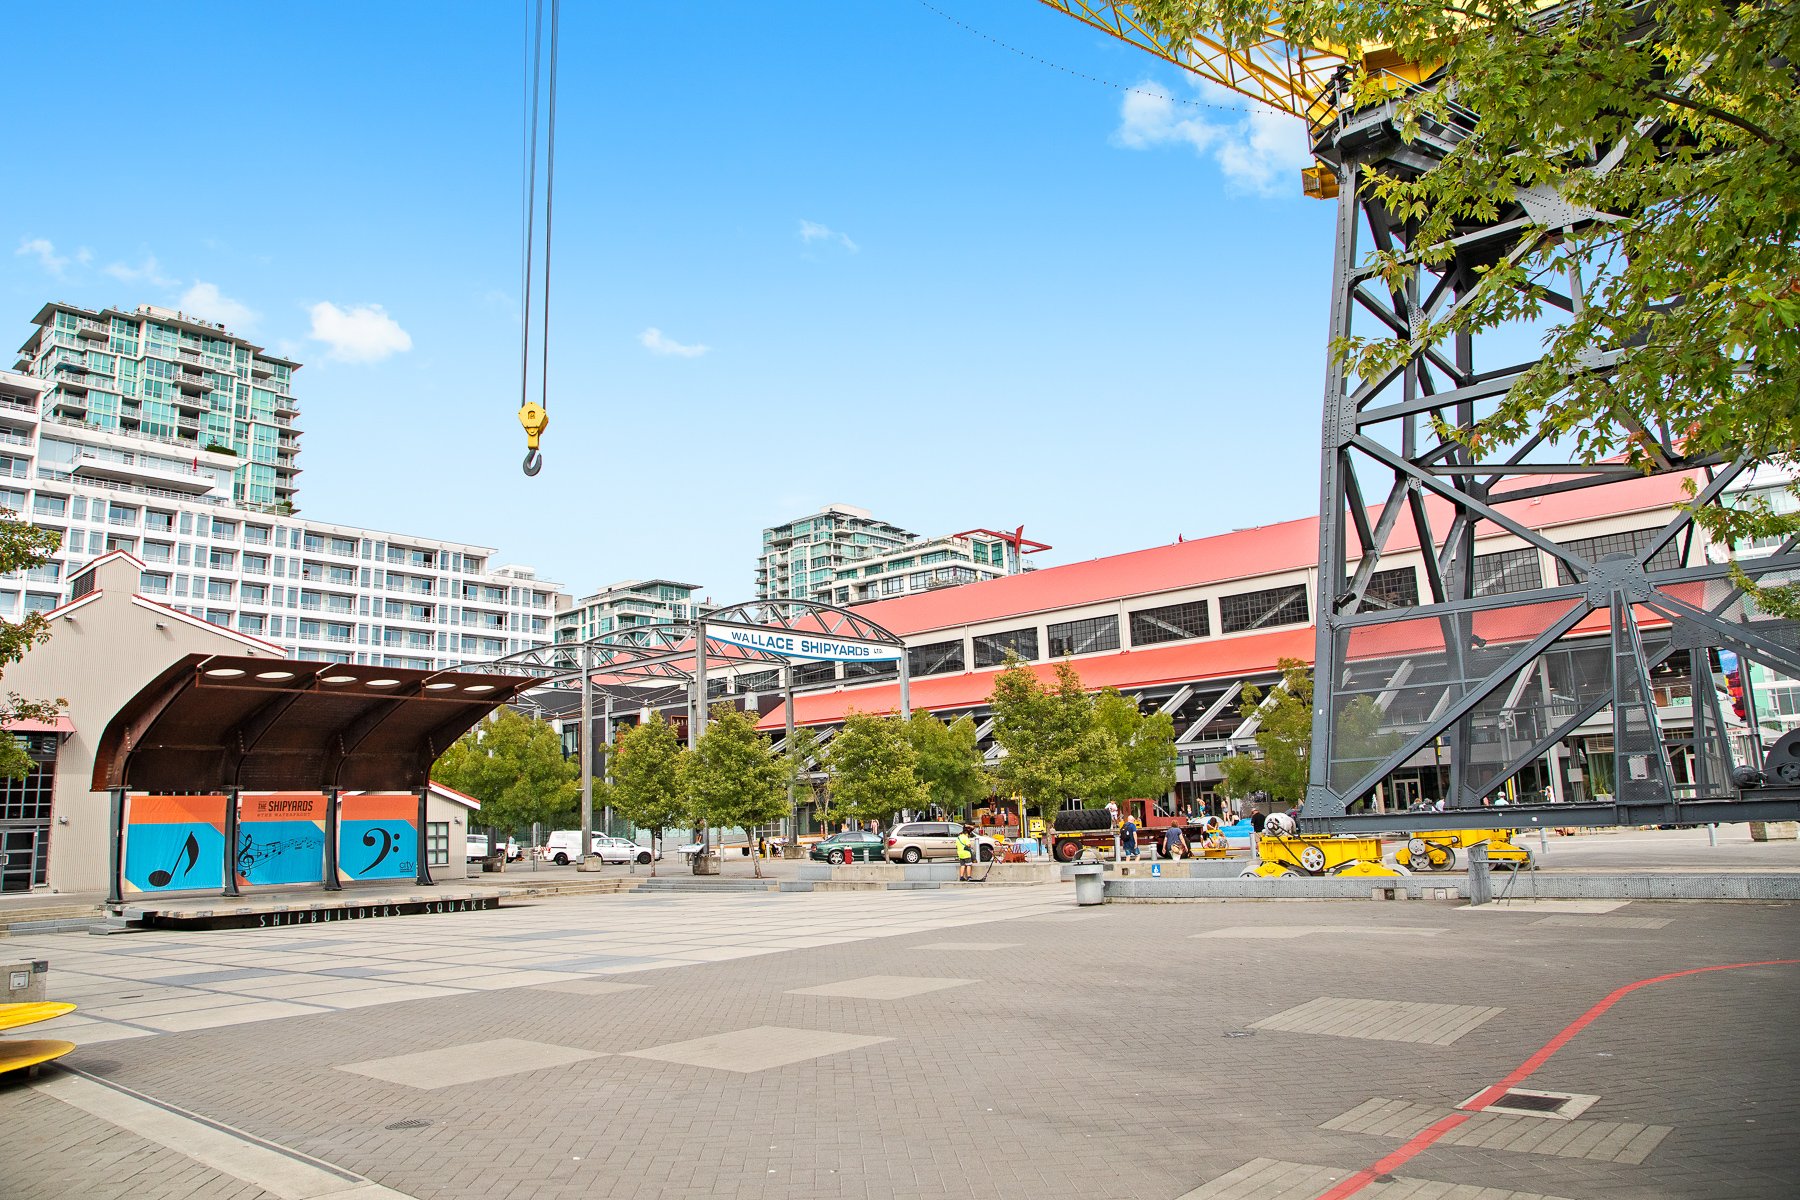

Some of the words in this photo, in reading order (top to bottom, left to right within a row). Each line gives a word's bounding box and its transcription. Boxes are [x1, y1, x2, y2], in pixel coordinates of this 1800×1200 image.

[731, 631, 794, 650] WALLACE
[801, 640, 869, 656] SHIPYARDS
[268, 800, 313, 812] SHIPYARDS
[260, 905, 400, 927] SHIPBUILDERS
[426, 899, 487, 914] SQUARE
